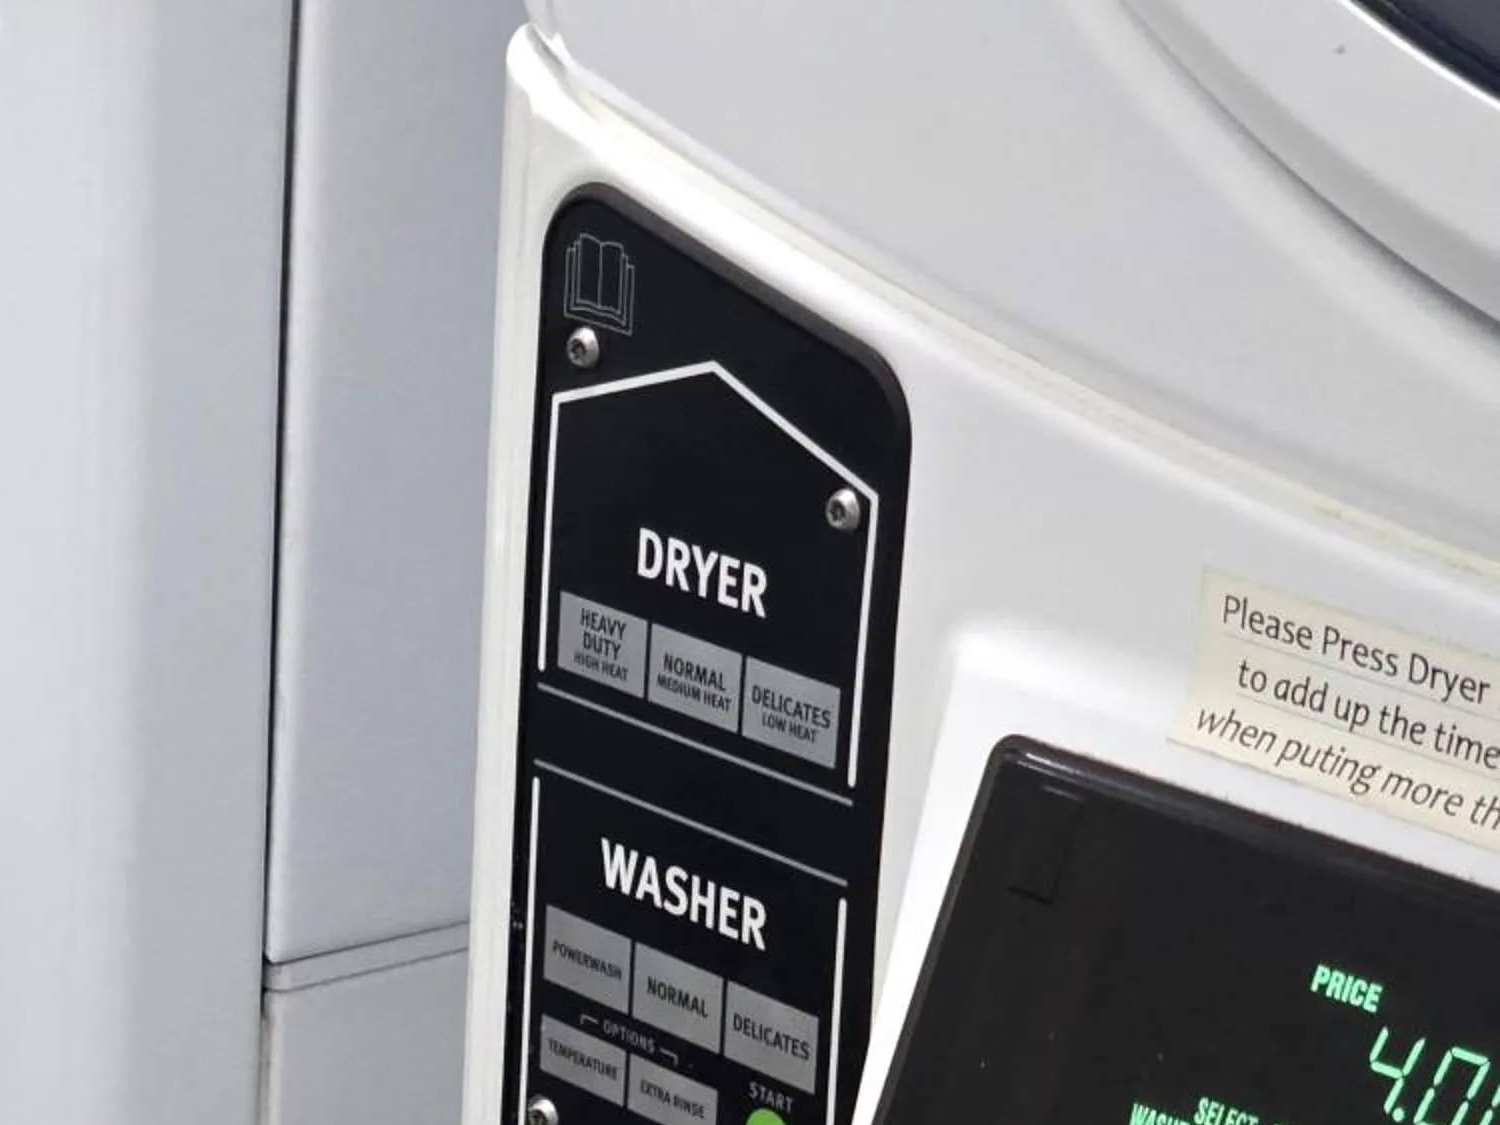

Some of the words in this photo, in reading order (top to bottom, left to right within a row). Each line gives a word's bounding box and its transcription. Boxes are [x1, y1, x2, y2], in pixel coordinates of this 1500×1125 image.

[637, 527, 768, 618] DRYER
[580, 607, 627, 641] HEAVY
[583, 631, 622, 660] DUTY
[1222, 594, 1314, 651] Please
[1321, 625, 1399, 678] Press
[1408, 653, 1491, 705] Dryer
[574, 652, 601, 673] HIGH
[602, 660, 628, 682] HEAT
[663, 653, 727, 692] NORMAL
[657, 674, 701, 701] MEDIUM
[703, 690, 732, 713] HEAT
[752, 685, 831, 729] DELICATES
[762, 712, 787, 733] LOW
[789, 722, 817, 744] HEAT
[1238, 659, 1267, 694] to
[1273, 676, 1328, 714] add
[1334, 695, 1370, 733] up
[1378, 704, 1427, 746] the
[1434, 721, 1500, 770] time
[1197, 706, 1277, 754] when
[1274, 738, 1382, 797] puting
[1380, 768, 1464, 817] more
[600, 836, 768, 950] WASHER
[552, 940, 622, 981] POWERWASH
[647, 976, 708, 1018] NORMAL
[1310, 964, 1383, 1013] PRICE
[602, 1018, 655, 1053] OPTIONS
[733, 1012, 811, 1061] DELICATES
[548, 1038, 618, 1081] TEMPERATURE
[640, 1078, 672, 1104] EXTRA
[674, 1093, 705, 1119] RINSE
[749, 1081, 794, 1114] START
